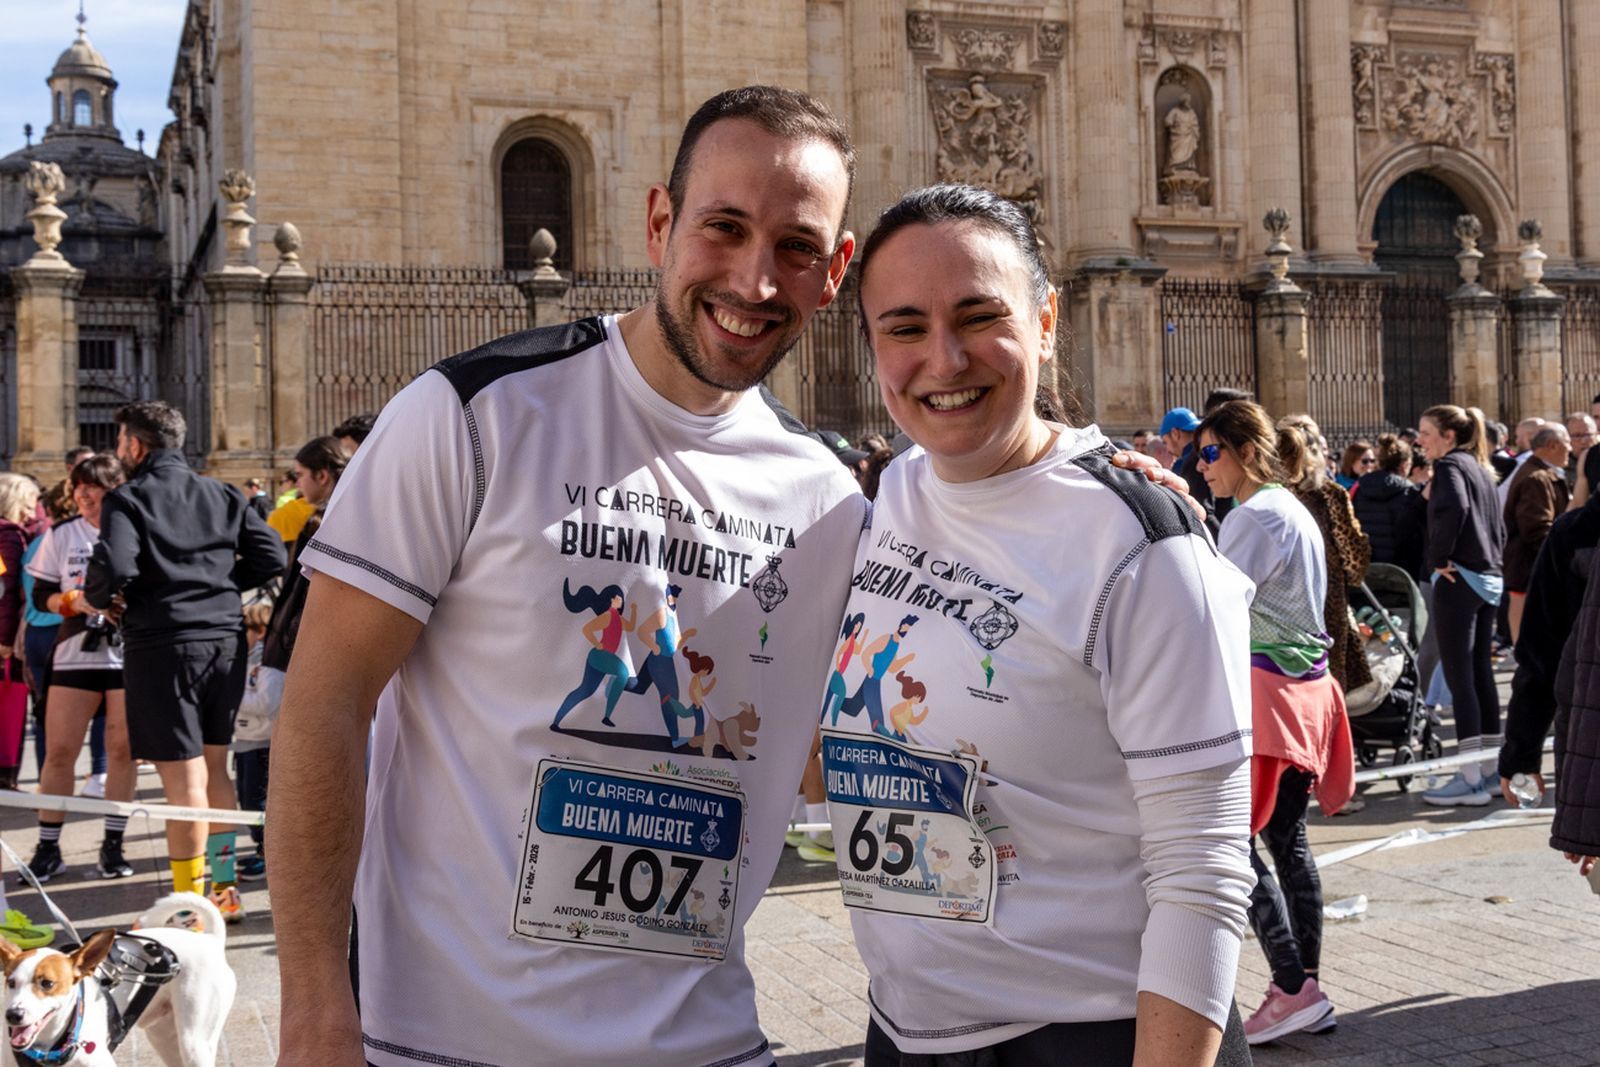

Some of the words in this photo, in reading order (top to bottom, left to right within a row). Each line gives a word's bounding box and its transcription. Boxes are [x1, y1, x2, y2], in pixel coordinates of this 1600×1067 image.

[565, 483, 586, 506] VI
[595, 487, 696, 524] CARRERA
[702, 509, 796, 549] CAMINATA
[560, 520, 650, 566] BUENA
[658, 534, 753, 589] MUERTE
[878, 530, 891, 548] VI
[836, 746, 887, 765] CARRERA
[889, 752, 943, 784] CAMINATA
[569, 777, 583, 794] VI
[586, 781, 654, 806] CARRERA
[659, 792, 724, 818] CAMINATA
[828, 769, 860, 797] BUENA
[862, 774, 931, 803] MUERTE
[562, 802, 620, 835] BUENA
[626, 812, 694, 846] MUERTE
[849, 810, 915, 876] 65
[529, 844, 539, 864] 2026
[574, 845, 704, 915] 407
[854, 873, 889, 887] MARTÍNEZ
[553, 905, 599, 919] ANTONIO
[600, 911, 626, 923] JESUS
[628, 914, 665, 928] GODINO
[666, 919, 708, 933] GONZALEZ
